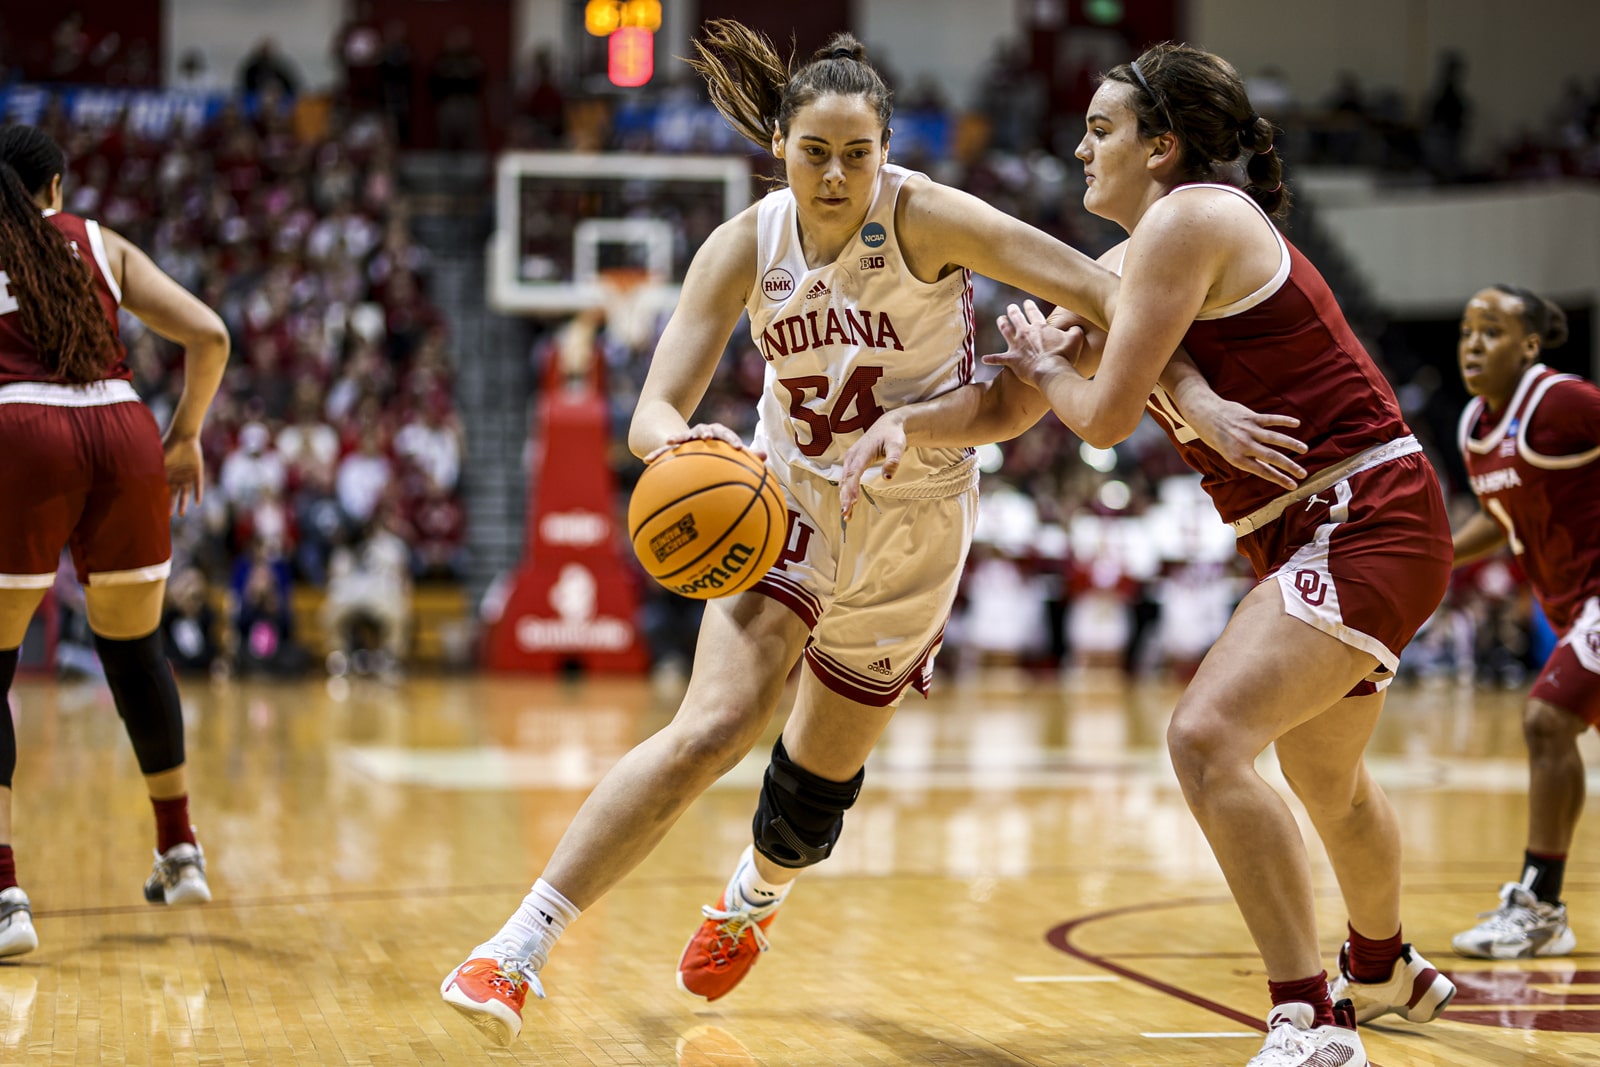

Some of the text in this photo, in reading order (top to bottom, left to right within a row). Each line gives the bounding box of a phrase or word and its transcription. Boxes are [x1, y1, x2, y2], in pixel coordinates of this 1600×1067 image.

[864, 234, 885, 243] NCAA
[765, 280, 792, 292] RMK
[806, 287, 832, 300] adidas
[761, 307, 905, 362] NDIANA
[778, 365, 885, 457] 54
[1294, 569, 1328, 607] OU
